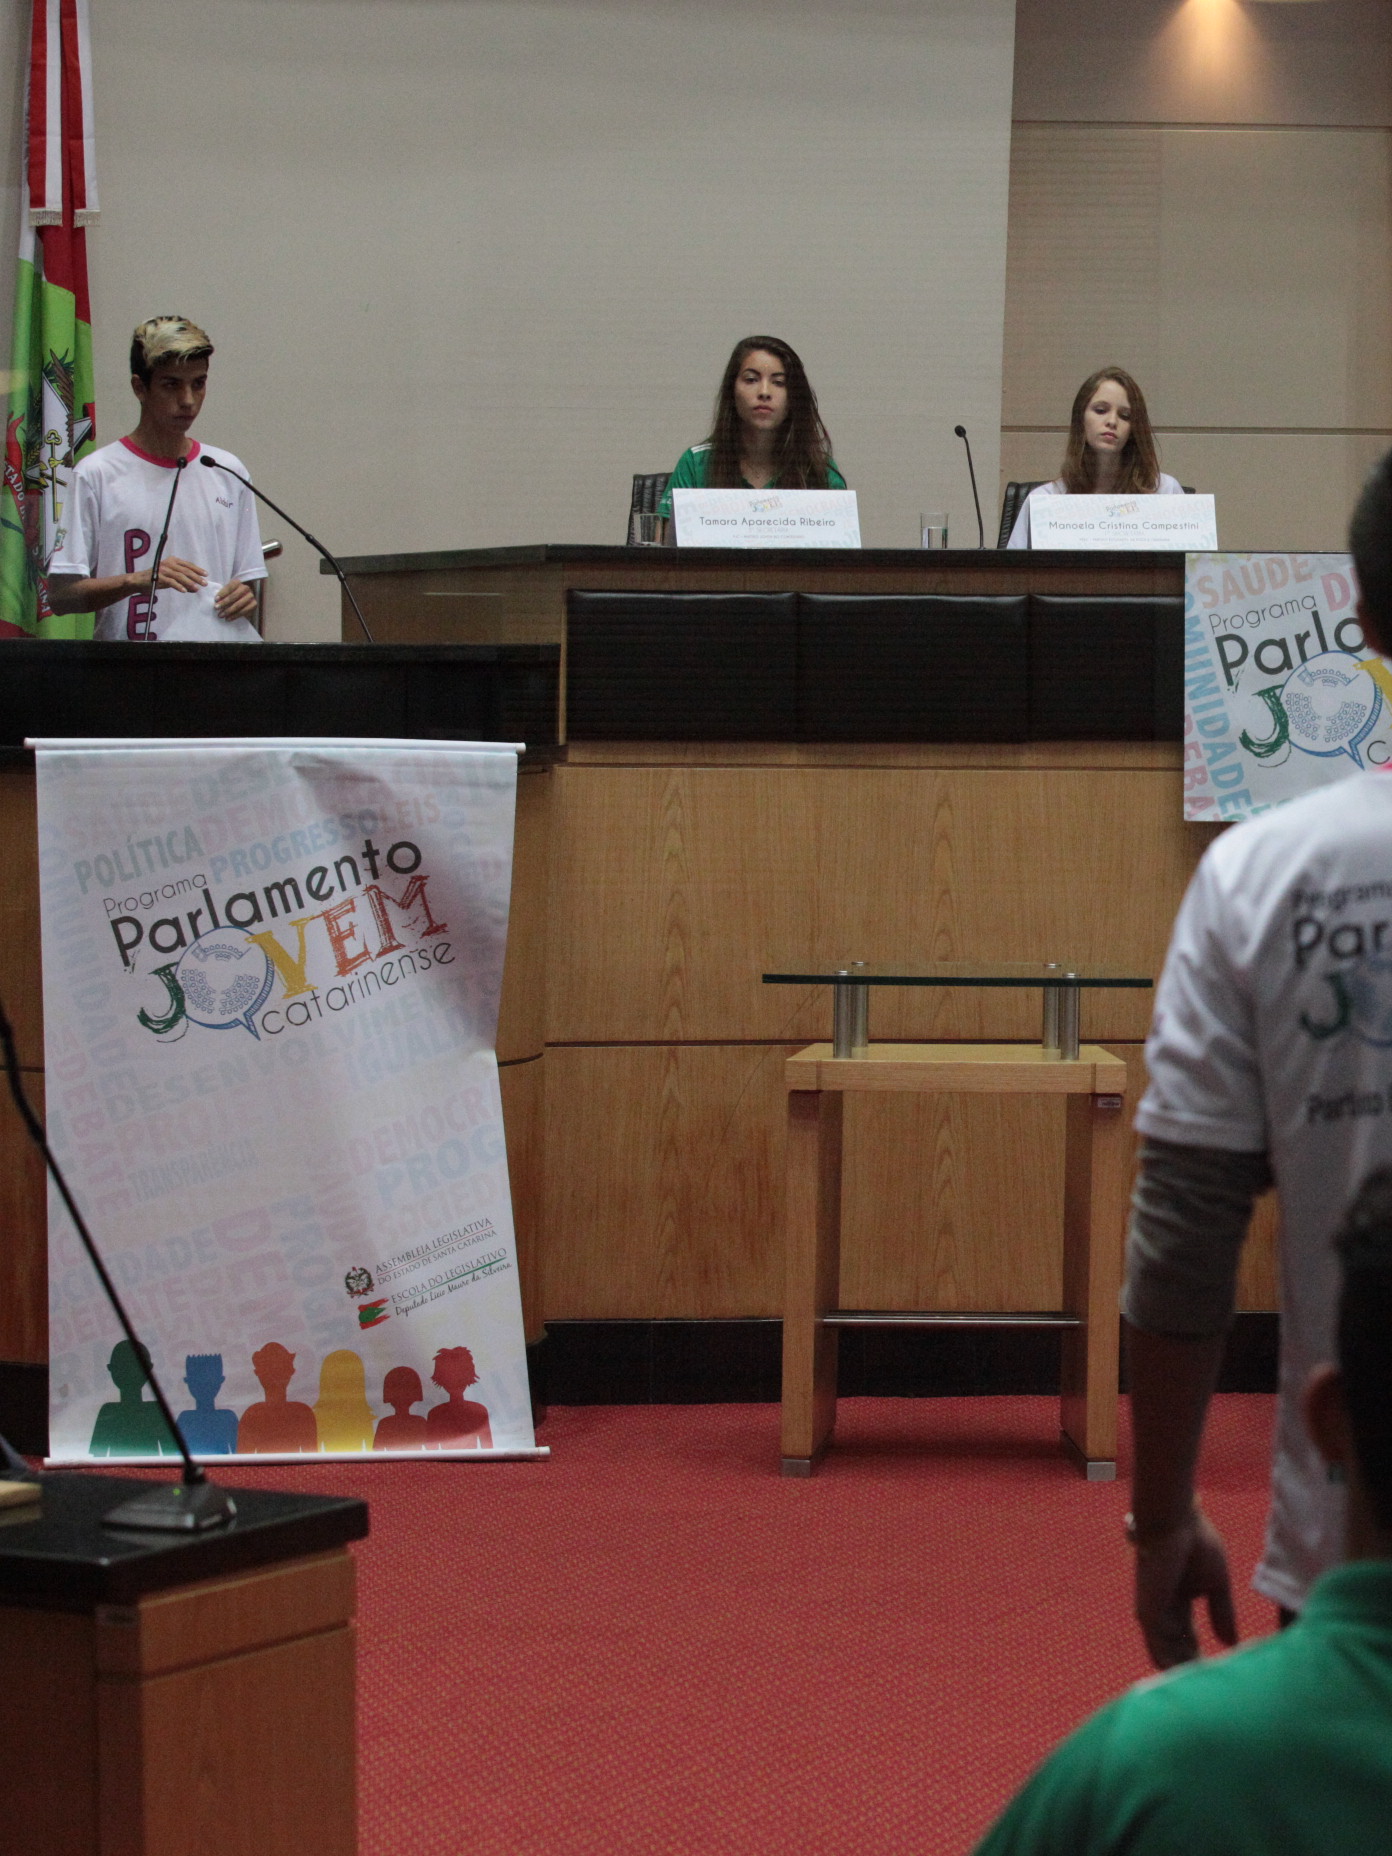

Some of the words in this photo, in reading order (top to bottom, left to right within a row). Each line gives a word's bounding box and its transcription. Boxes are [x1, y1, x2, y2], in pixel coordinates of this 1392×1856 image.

[699, 516, 738, 527] Tamara
[741, 516, 797, 529] Aparecida
[800, 517, 836, 528] Ribeiro
[1049, 521, 1095, 531] Manoela
[1098, 520, 1138, 531] Cristina
[1142, 520, 1199, 532] Campestini
[1209, 594, 1318, 635] Programa
[73, 824, 204, 896] POLÍTICA
[208, 808, 379, 885] PROGRESSO
[103, 872, 207, 919] Programa
[109, 839, 422, 967] Parlamento
[138, 874, 450, 1042] JOVEM
[260, 940, 456, 1036] catarinense
[375, 1243, 431, 1274] ASSEMBLEIA
[432, 1217, 493, 1247] LEGISLATIVA
[378, 1275, 392, 1285] DO
[393, 1261, 421, 1279] ESTADO
[422, 1257, 433, 1267] DE
[433, 1246, 457, 1262] SANTA
[457, 1229, 497, 1250] CATARINA
[391, 1282, 427, 1304] ESCOLA
[428, 1274, 444, 1288] DO
[444, 1247, 507, 1280] LEGISLATIVO
